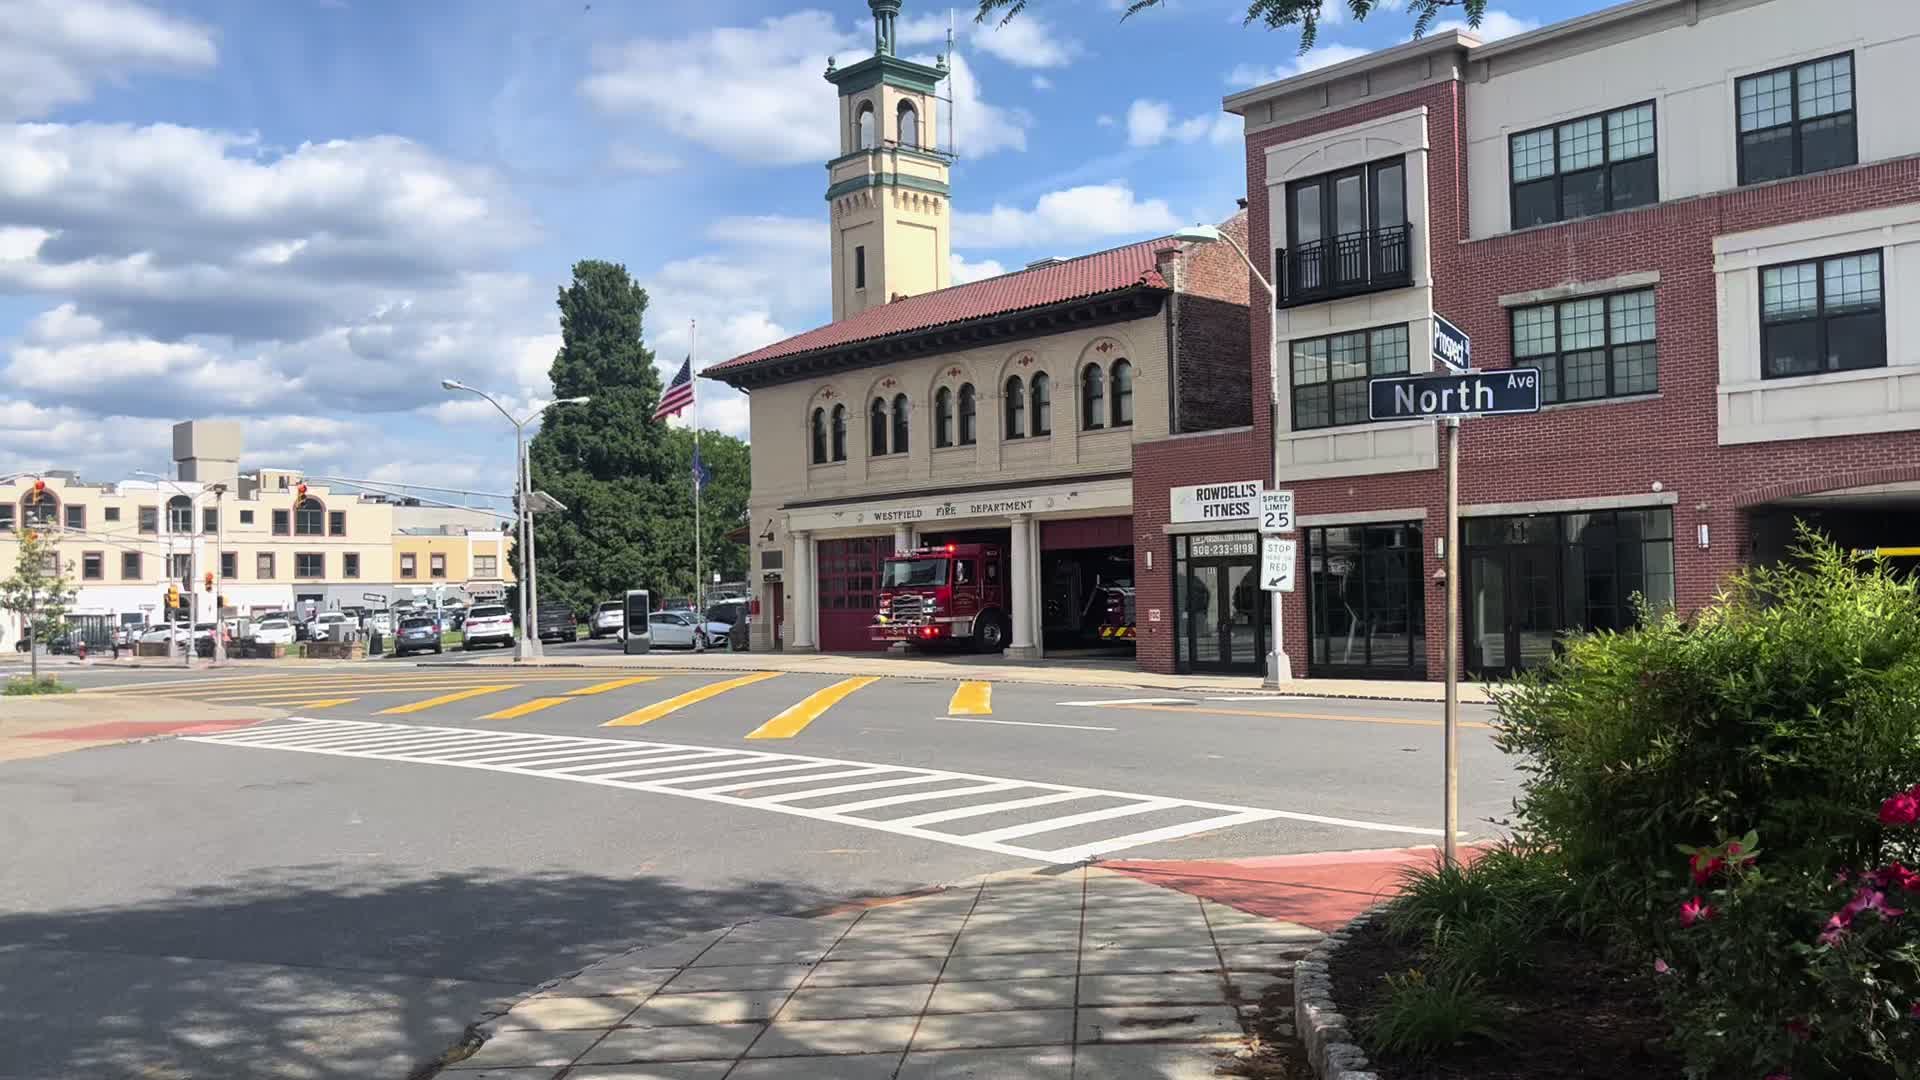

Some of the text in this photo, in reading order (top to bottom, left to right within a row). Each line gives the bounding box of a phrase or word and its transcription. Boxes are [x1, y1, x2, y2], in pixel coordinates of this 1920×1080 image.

[1435, 321, 1464, 366] Prospect
[1395, 374, 1534, 414] North Ave
[1196, 484, 1256, 501] ROWDELL'S
[1263, 495, 1290, 503] SPEED
[874, 500, 1033, 520] WESTFIELD FIRE DEPARTMENT
[1203, 502, 1250, 518] FITNESS
[1265, 512, 1289, 528] 25
[1268, 544, 1291, 553] STOP
[1269, 563, 1288, 572] RED
